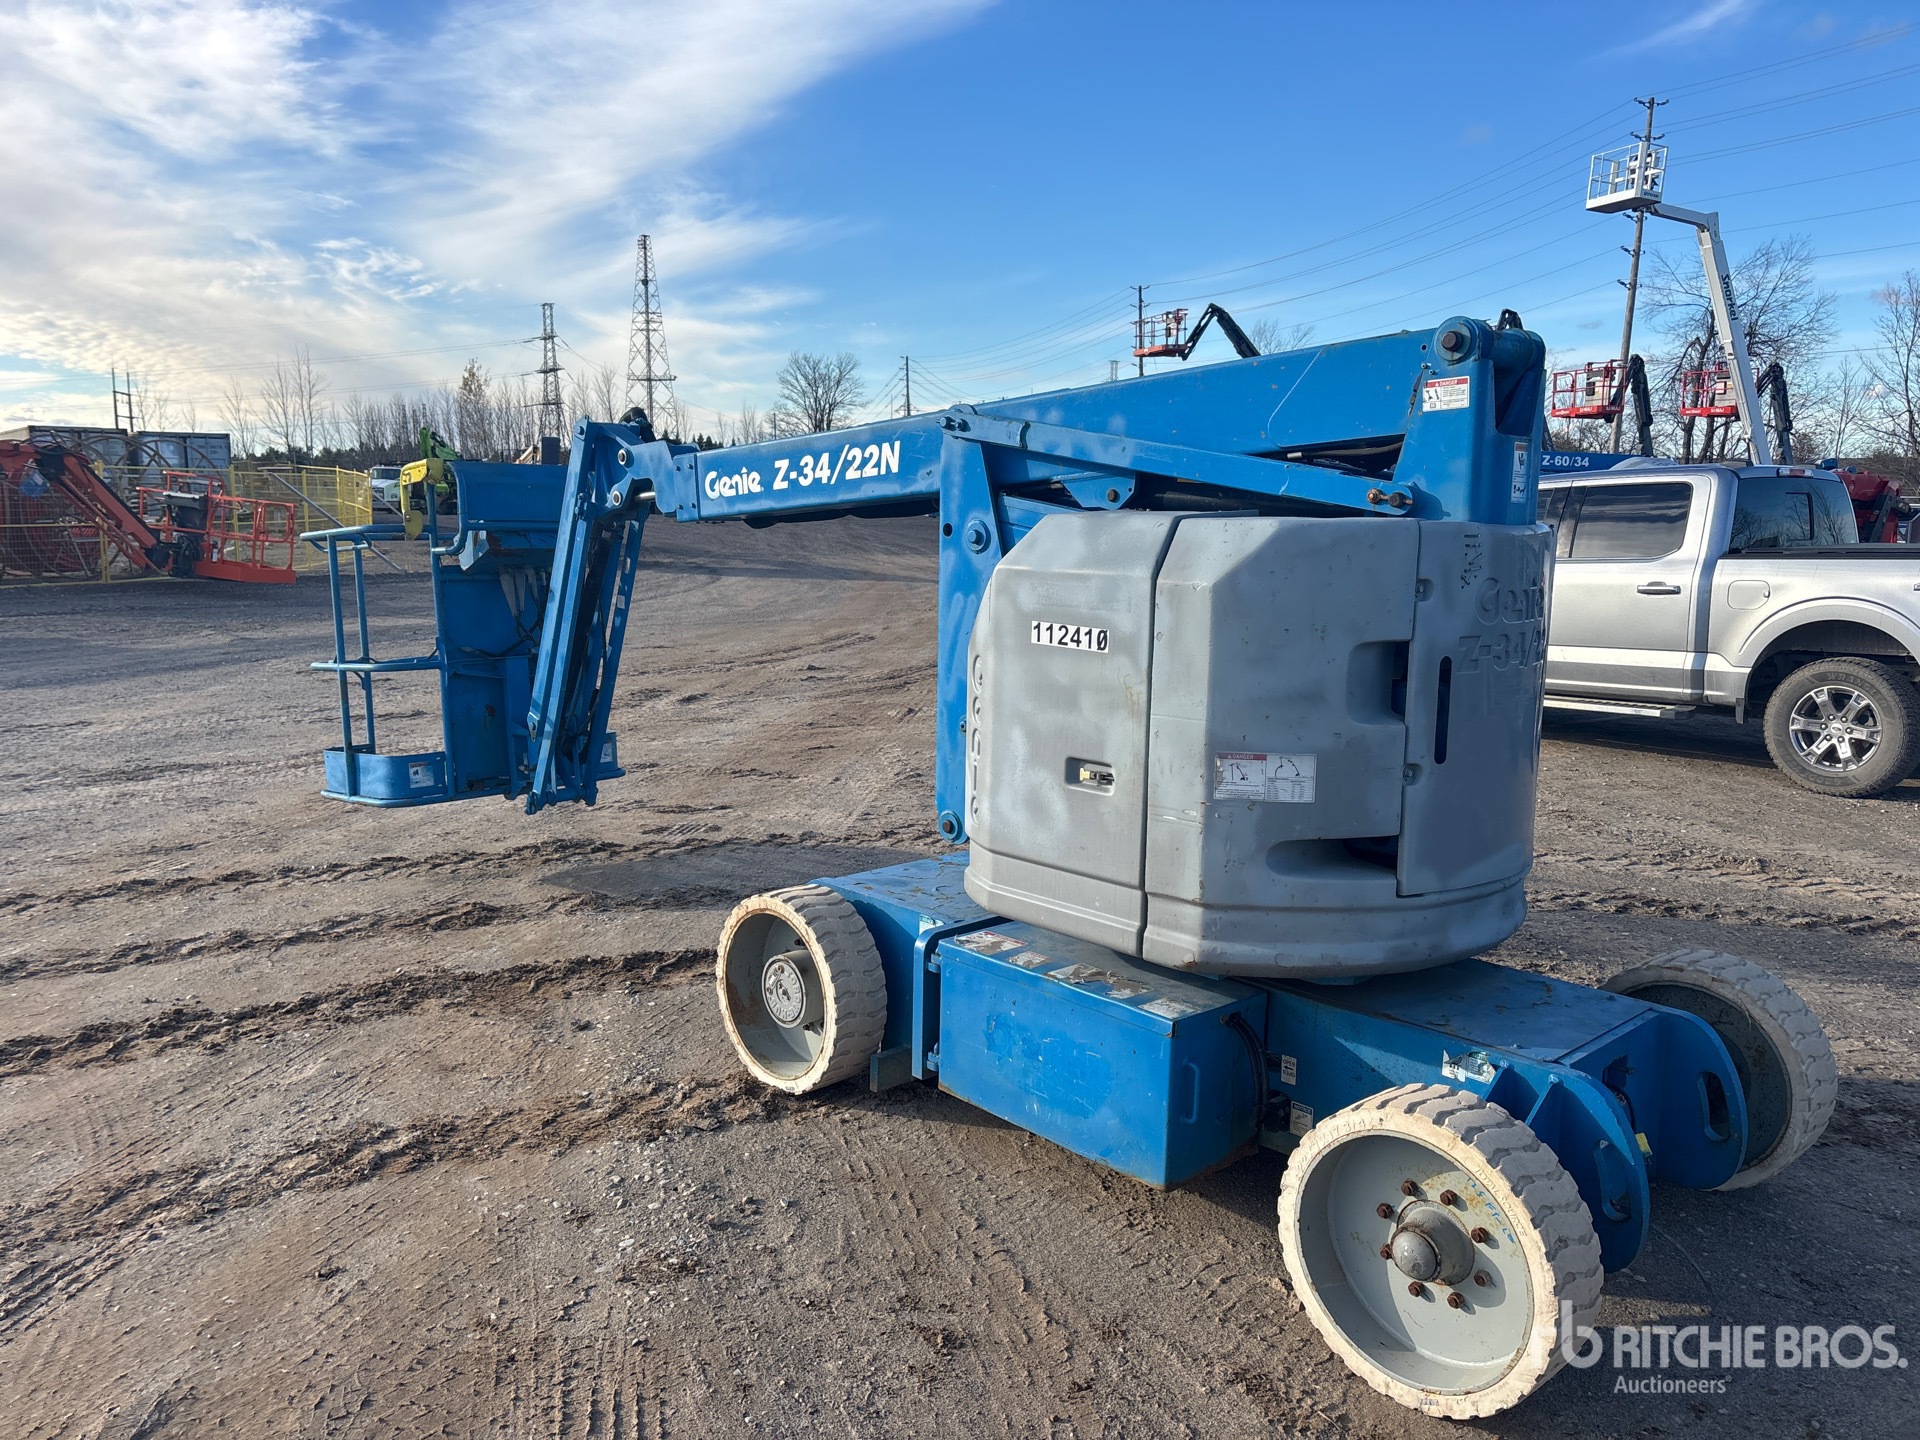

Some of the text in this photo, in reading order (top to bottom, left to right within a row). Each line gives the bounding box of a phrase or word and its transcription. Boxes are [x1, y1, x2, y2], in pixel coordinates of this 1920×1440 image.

[1721, 273, 1739, 321] Snorkel
[704, 440, 900, 500] Genie Z-34/22N
[1542, 455, 1590, 467] Z-60/34
[1033, 622, 1108, 652] 112410
[1283, 1059, 1295, 1067] OPEN
[1293, 1104, 1311, 1114] NOTICE
